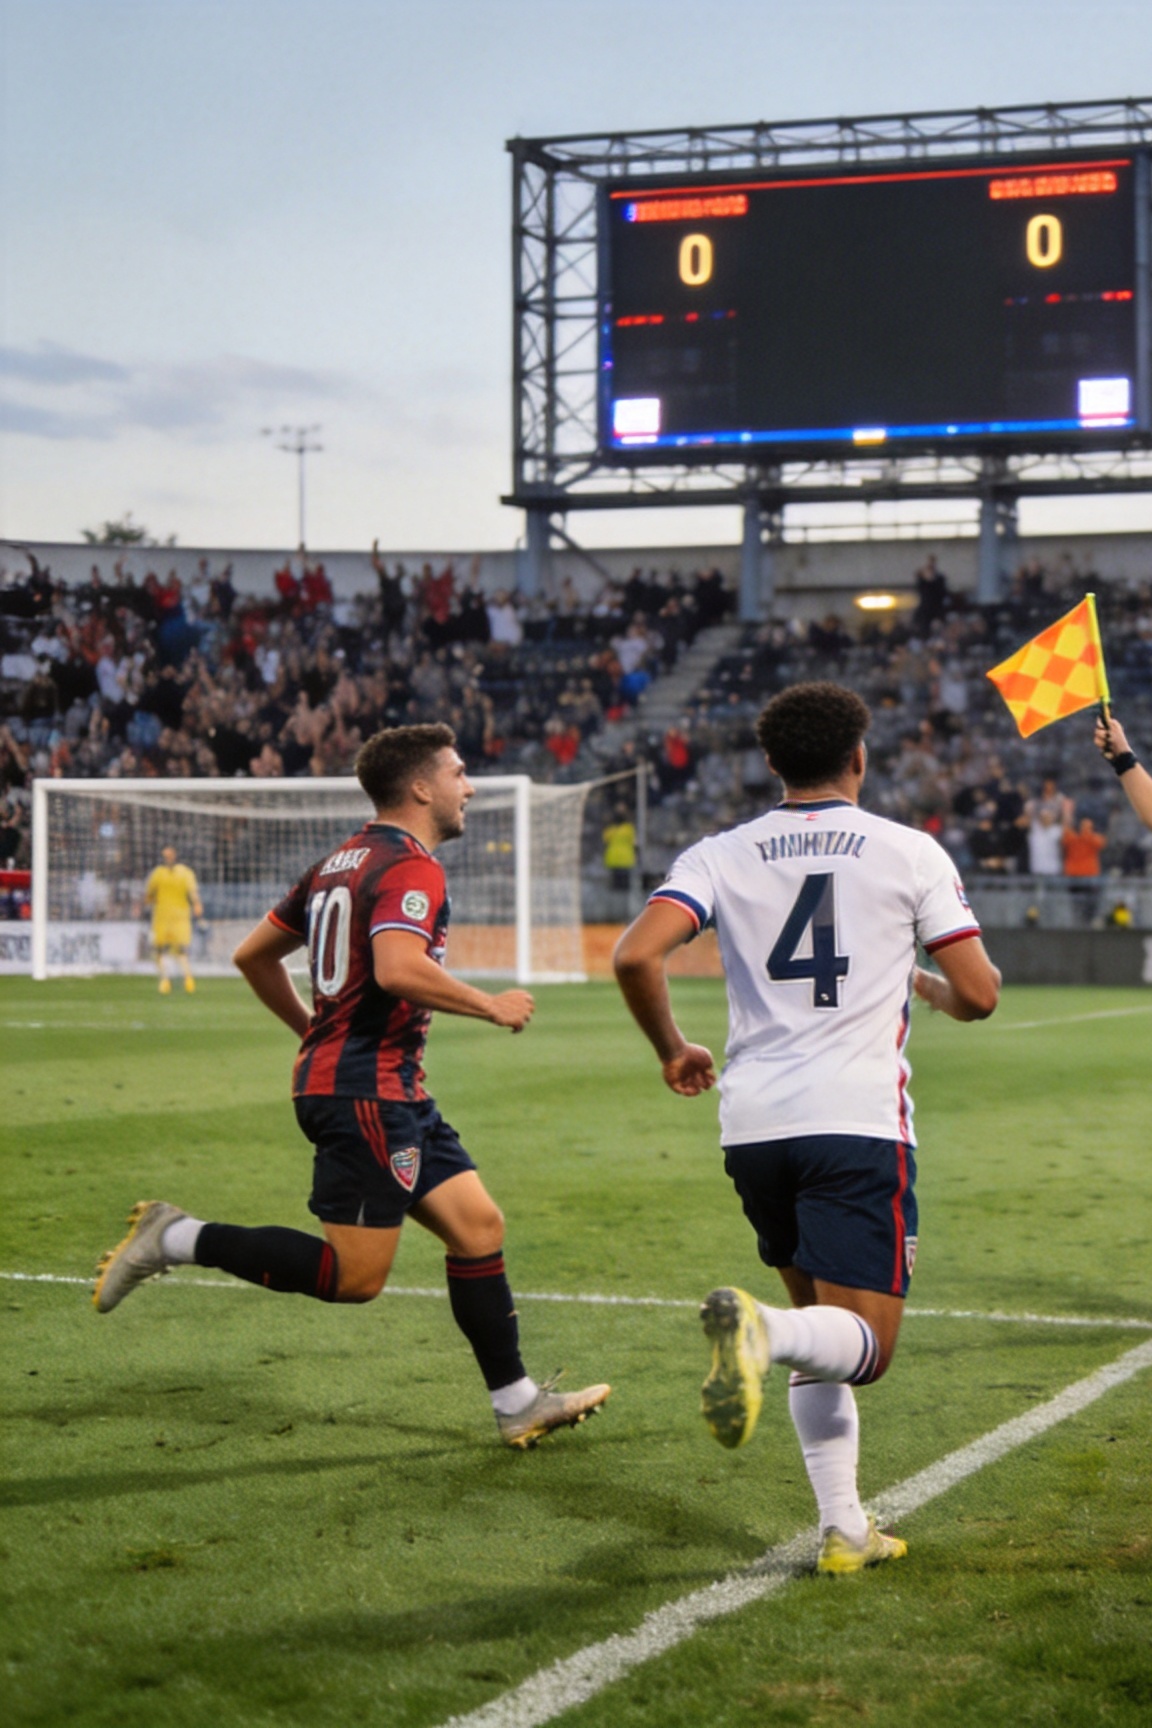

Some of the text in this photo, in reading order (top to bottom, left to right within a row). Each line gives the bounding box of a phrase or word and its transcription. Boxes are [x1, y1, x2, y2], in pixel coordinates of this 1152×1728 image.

[679, 233, 713, 285] 0
[1026, 214, 1062, 267] 0
[307, 886, 351, 996] 10
[765, 871, 850, 1010] 4
